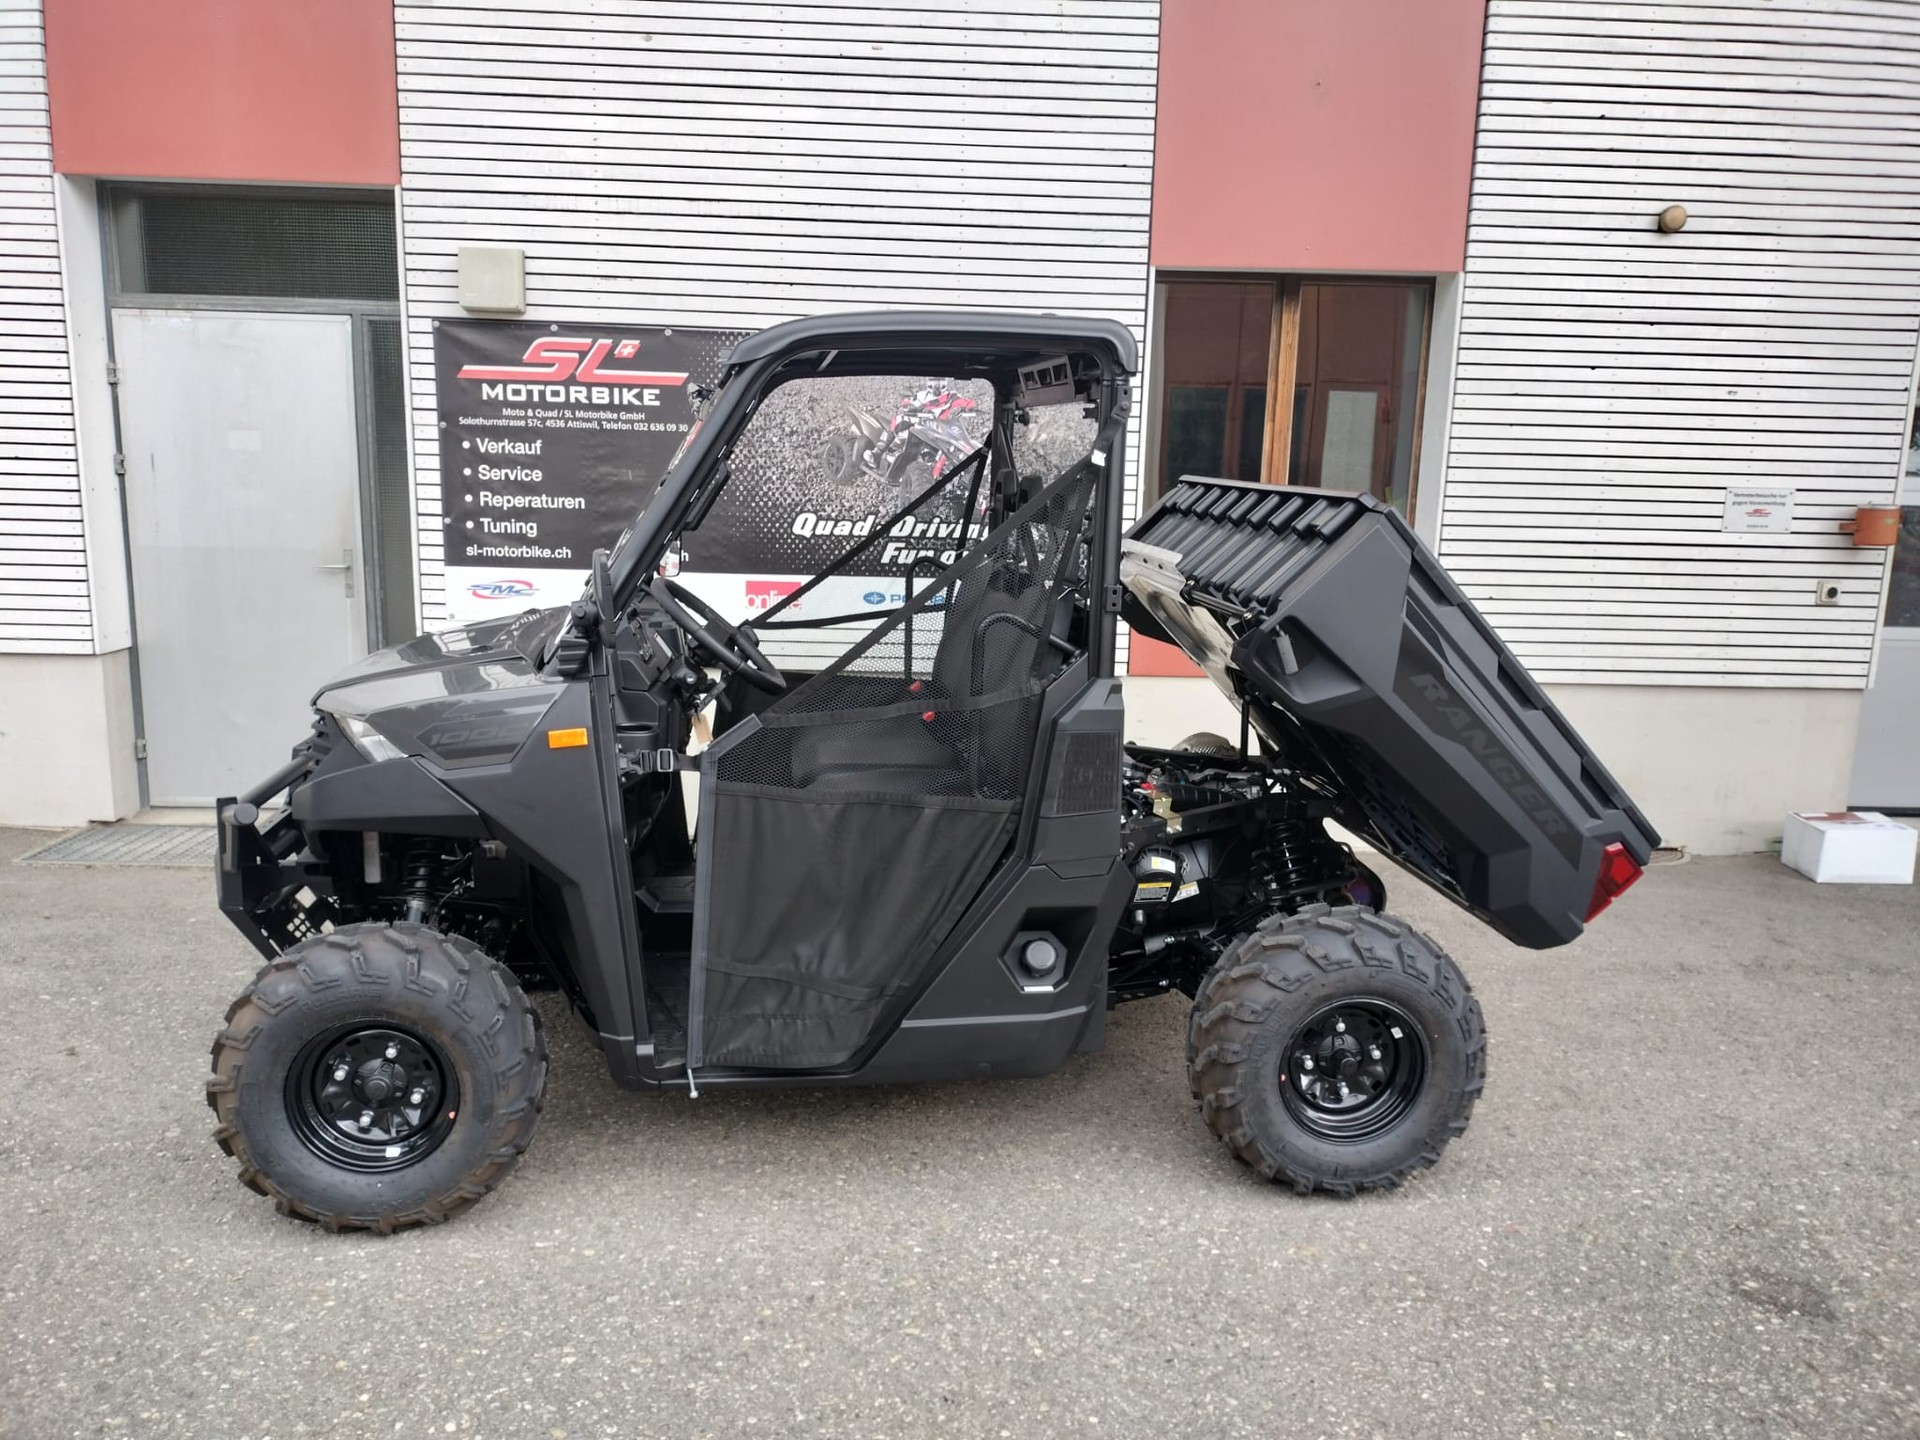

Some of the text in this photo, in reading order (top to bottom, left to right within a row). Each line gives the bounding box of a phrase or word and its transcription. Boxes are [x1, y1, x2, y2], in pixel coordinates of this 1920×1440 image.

[457, 337, 689, 386] SL
[481, 383, 661, 406] MOTORBIKE
[502, 408, 525, 417] Moto
[527, 408, 533, 417] &
[535, 409, 558, 418] Quad
[564, 410, 573, 418] SL
[575, 410, 618, 419] Motorbike
[619, 411, 645, 420] GmbH
[459, 416, 688, 432] Solothurnstrasse 57c, 4536 Attiswil, Telefon 032 636 09 30
[476, 437, 542, 455] Verkauf
[478, 464, 543, 481] Service
[479, 491, 585, 510] Reperaturen
[479, 517, 537, 537] Tuning
[792, 512, 876, 538] Quad
[466, 544, 571, 559] sl-motorbike.ch
[1408, 674, 1568, 836] RANGER
